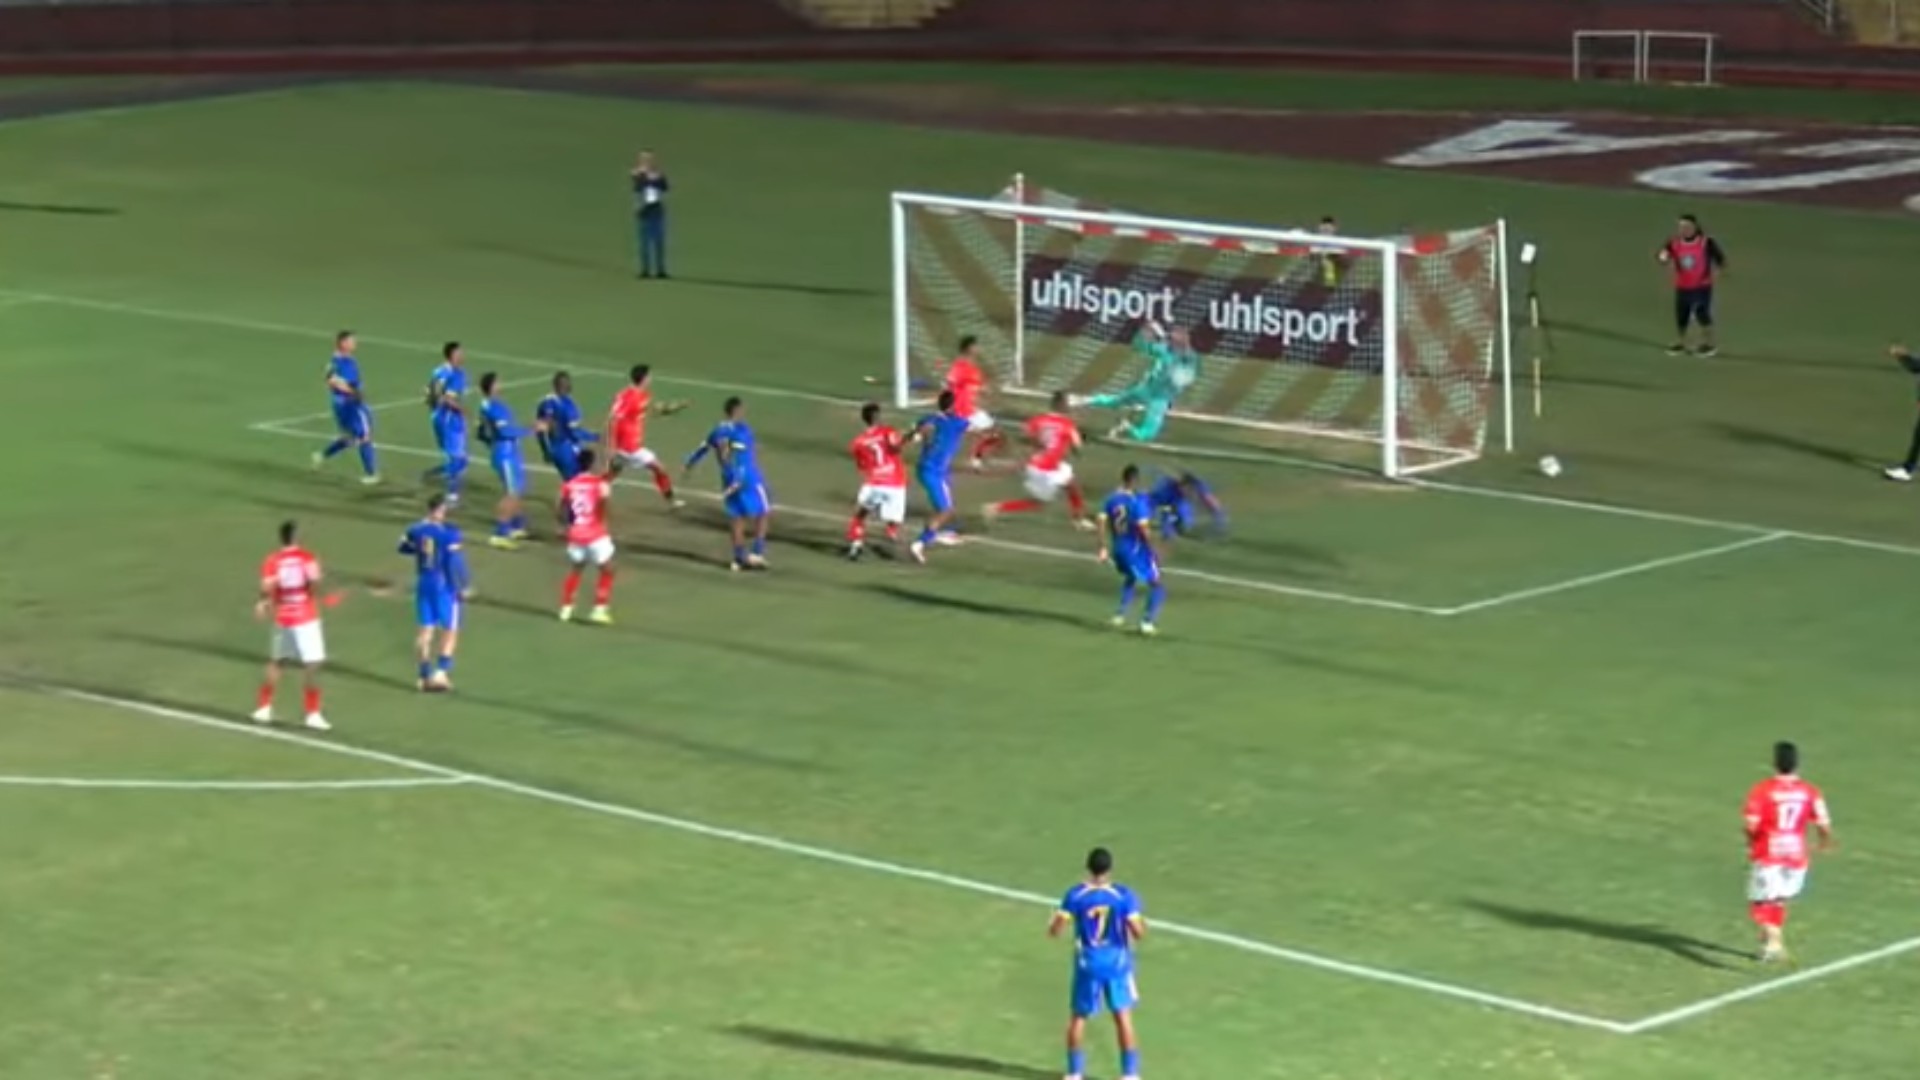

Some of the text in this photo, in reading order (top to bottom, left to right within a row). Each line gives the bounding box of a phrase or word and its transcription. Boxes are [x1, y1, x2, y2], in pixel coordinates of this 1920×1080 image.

[1031, 272, 1358, 346] uhlsport uhlsport
[1777, 801, 1804, 830] 17
[1087, 904, 1112, 946] 7
